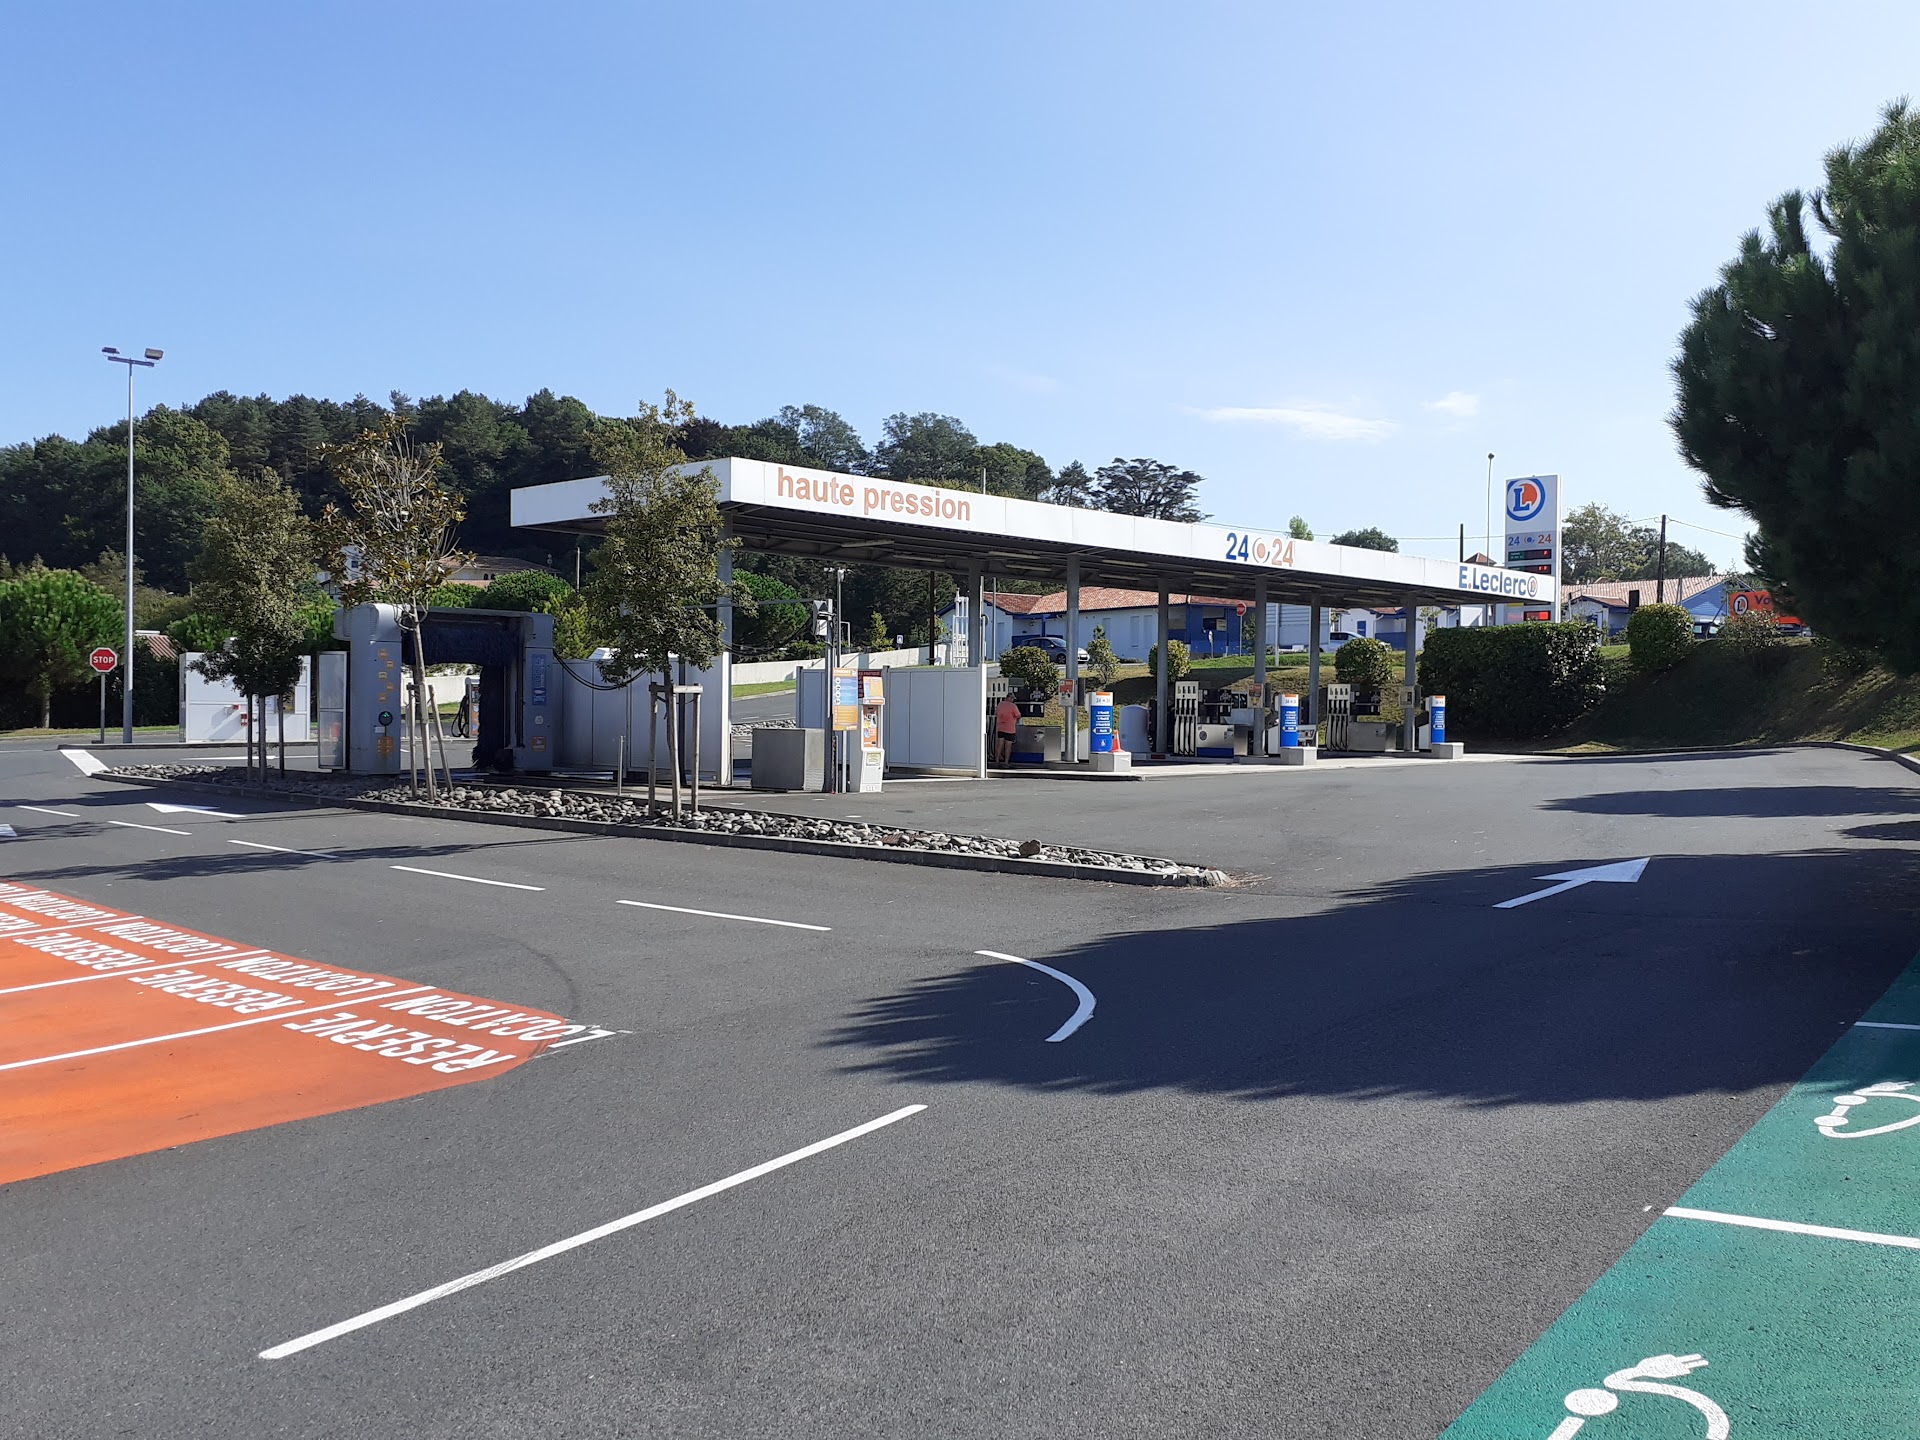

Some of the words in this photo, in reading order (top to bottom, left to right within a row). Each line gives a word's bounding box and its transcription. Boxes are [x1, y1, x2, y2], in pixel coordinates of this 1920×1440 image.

[778, 467, 854, 506] haute
[864, 487, 971, 522] pression
[1226, 532, 1249, 562] 24
[1271, 538, 1294, 567] 24
[1508, 535, 1520, 546] 24
[1538, 534, 1552, 544] 24
[1458, 565, 1527, 596] E.Leclerc
[93, 656, 114, 664] STOP
[13, 933, 155, 970] RESERVE
[93, 921, 237, 957] LOCATION
[128, 969, 305, 1013] RESERVE
[216, 956, 396, 996] LOCATION
[379, 995, 616, 1049] LOCATION
[281, 1012, 516, 1074] RESERVE
